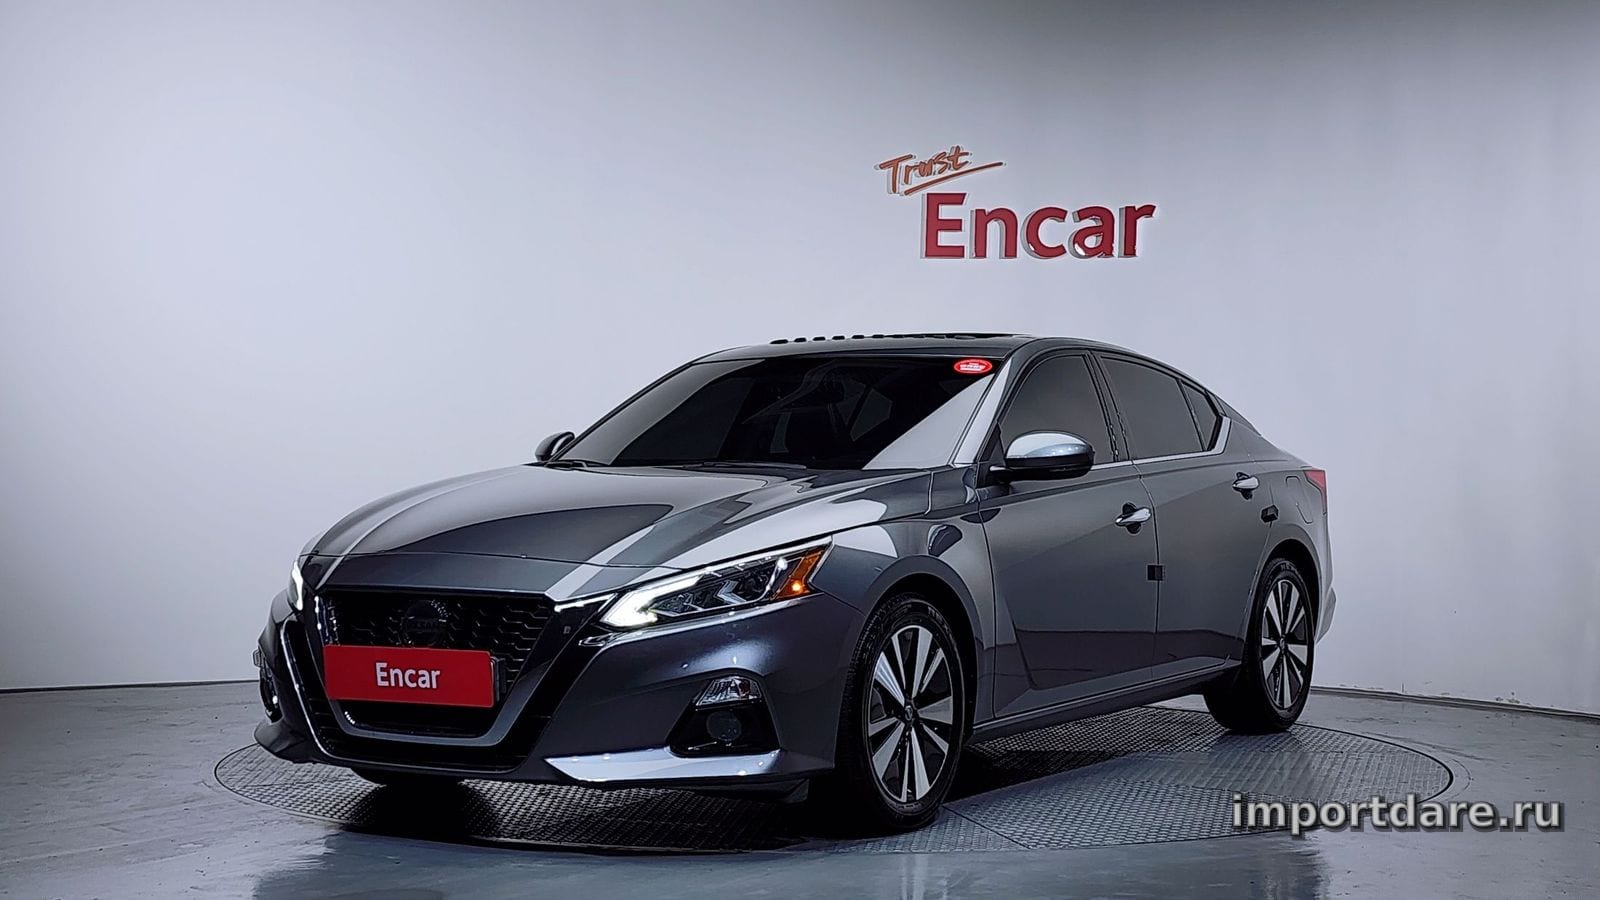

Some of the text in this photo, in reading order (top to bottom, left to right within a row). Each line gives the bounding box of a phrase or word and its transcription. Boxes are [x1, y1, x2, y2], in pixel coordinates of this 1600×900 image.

[878, 146, 971, 194] Trust
[921, 192, 1156, 259] Encar
[375, 661, 441, 689] Encar
